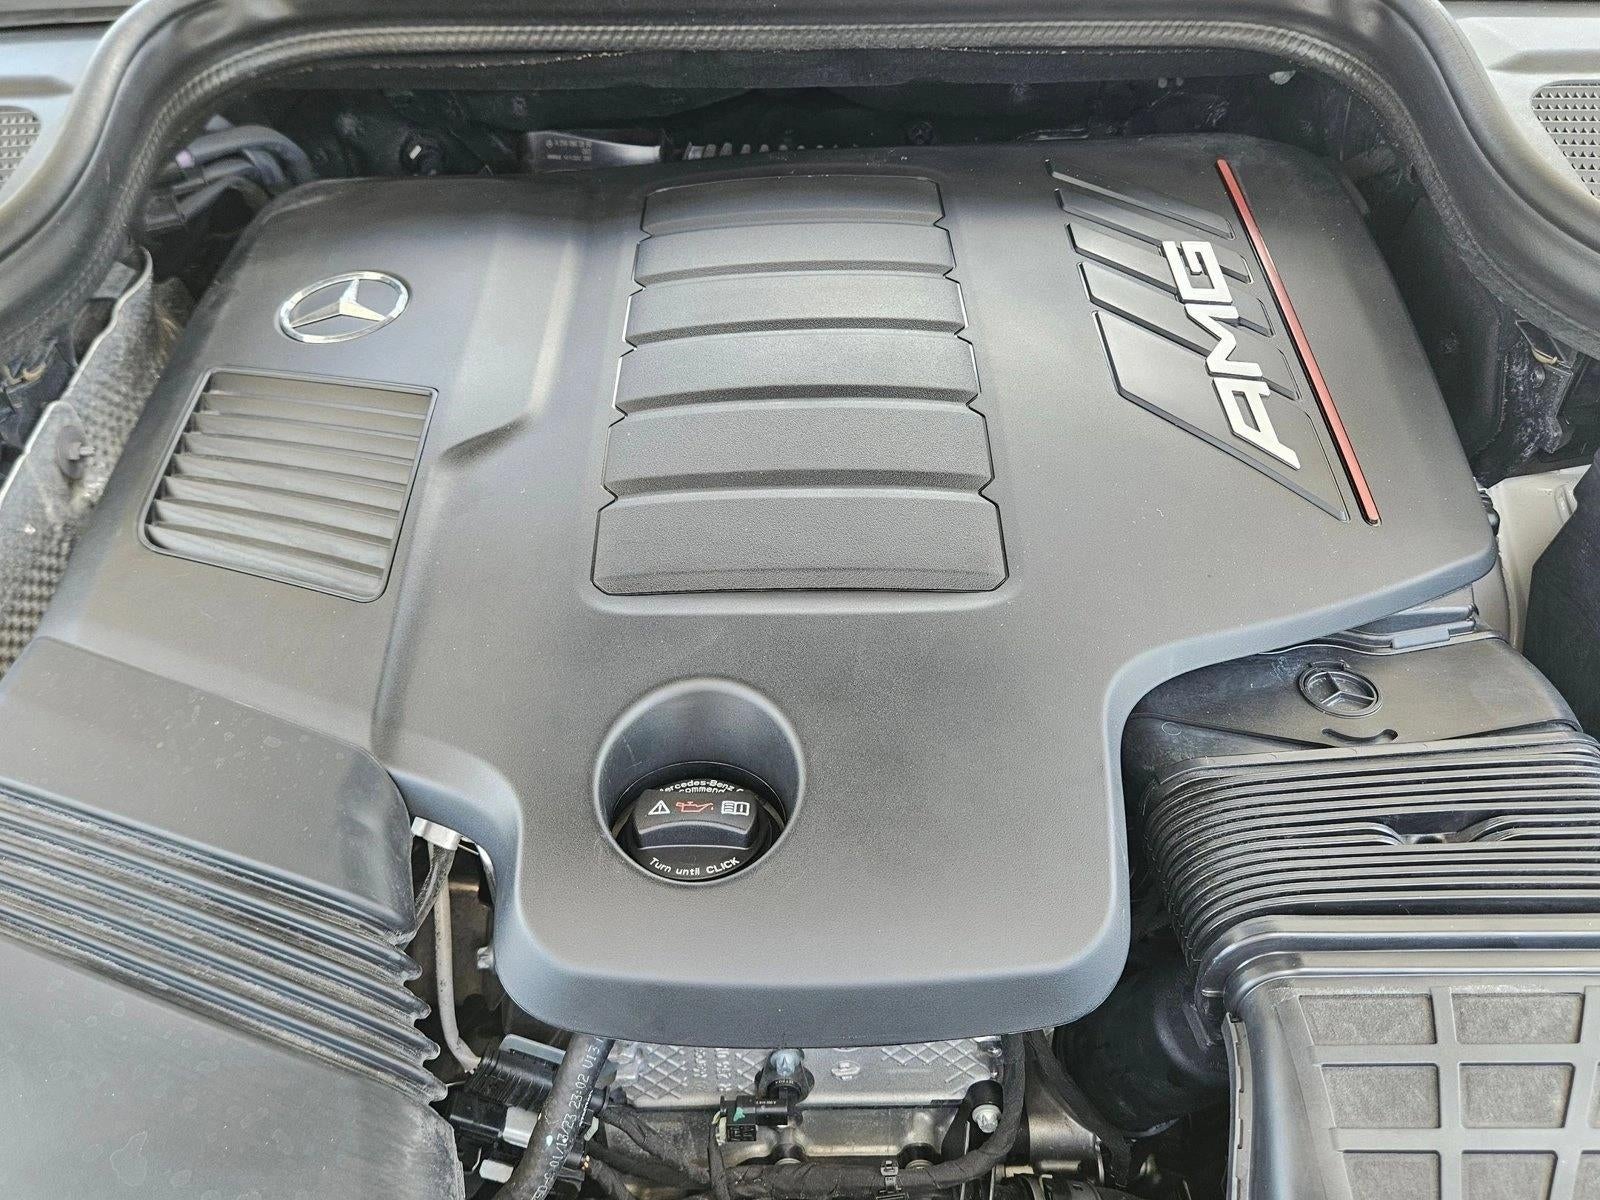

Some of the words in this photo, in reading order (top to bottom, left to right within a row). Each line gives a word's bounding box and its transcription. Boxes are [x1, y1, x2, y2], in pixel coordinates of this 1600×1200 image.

[1161, 240, 1301, 470] AMG
[660, 779, 735, 792] ercedes-Benz
[648, 857, 672, 873] Turn
[675, 867, 701, 876] until
[705, 857, 740, 874] CLICK
[568, 1073, 590, 1109] 23:02
